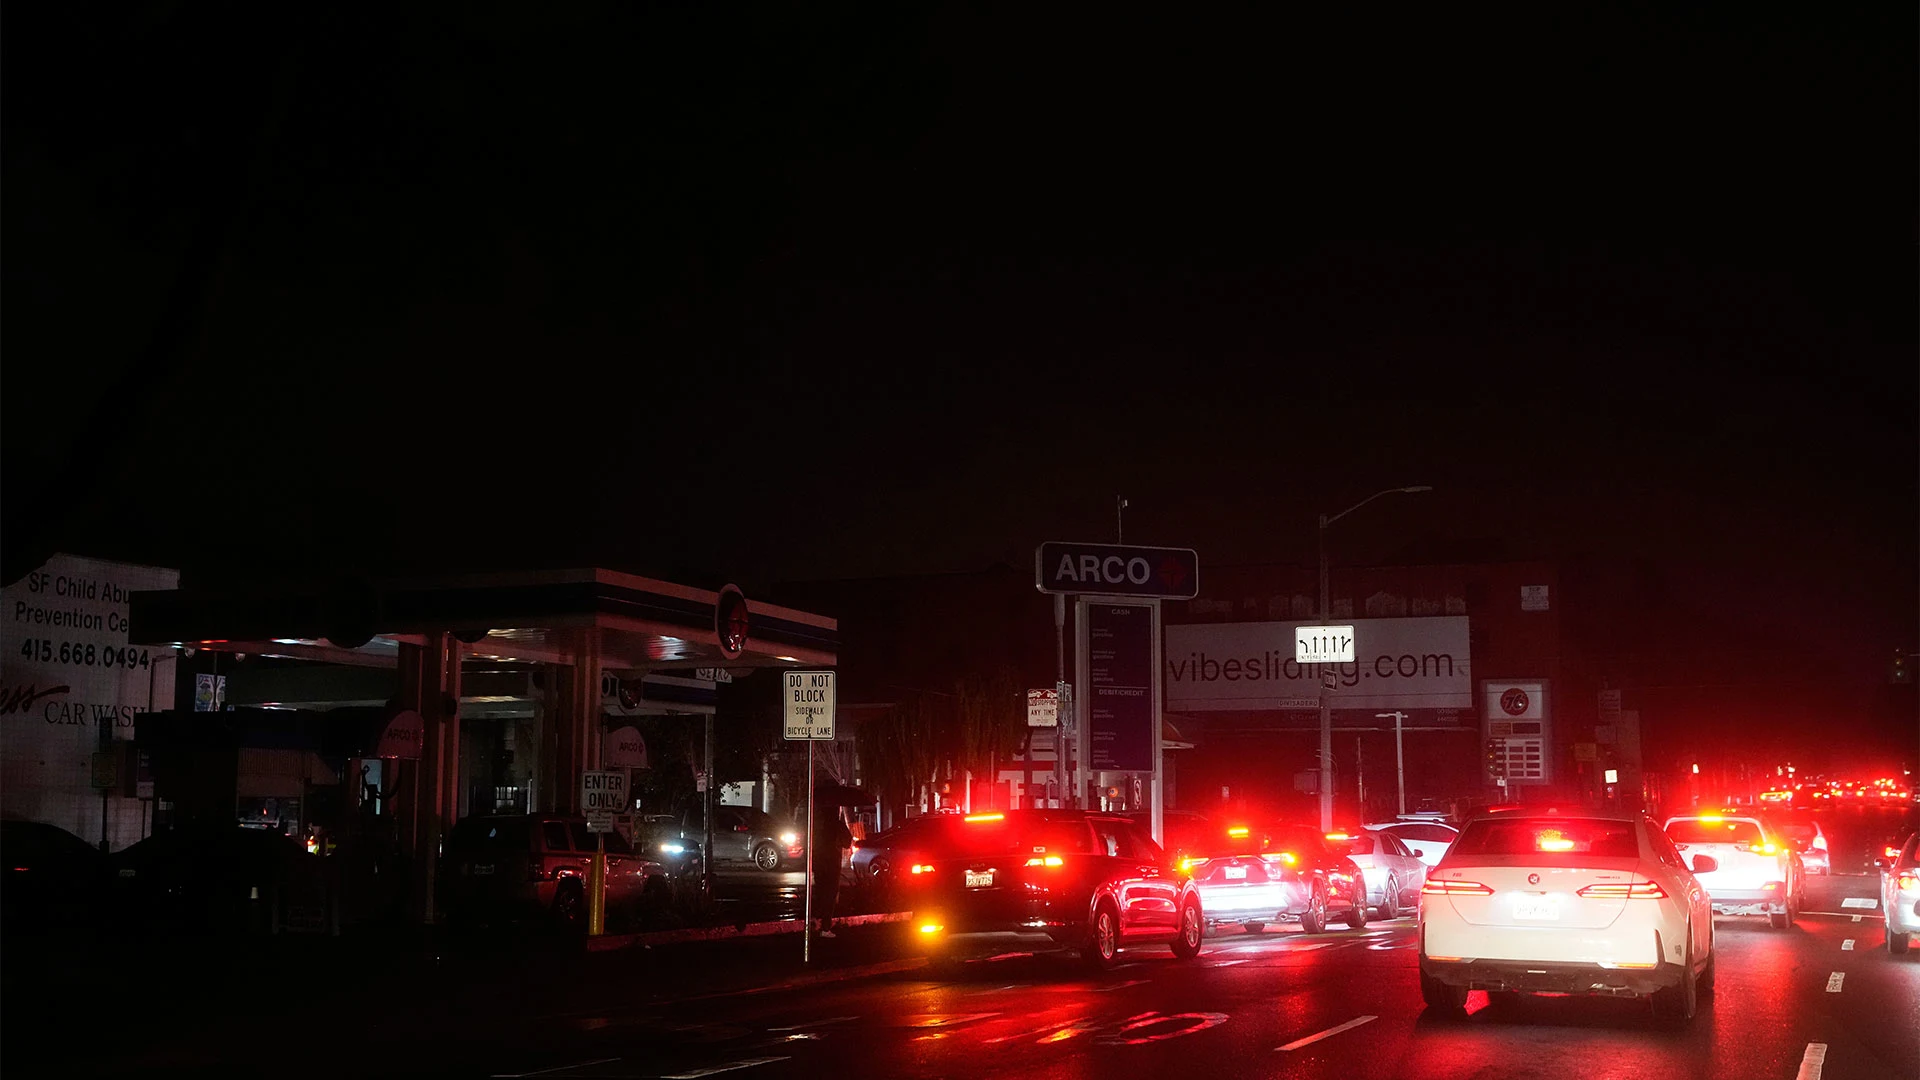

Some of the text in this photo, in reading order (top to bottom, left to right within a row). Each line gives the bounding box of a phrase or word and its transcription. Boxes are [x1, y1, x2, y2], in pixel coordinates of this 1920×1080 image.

[1056, 553, 1151, 585] ARCO
[28, 572, 50, 594] SF
[56, 576, 96, 600] Child
[15, 601, 102, 630] Prevention
[21, 638, 149, 670] 415.668.0494
[790, 675, 829, 687] DO NOT
[794, 690, 825, 702] BLOCK
[1504, 693, 1525, 711] 76
[44, 701, 146, 728] CAR WAS
[795, 707, 825, 715] SIDEWALK
[788, 727, 831, 735] BICYCLE LANE
[618, 742, 638, 753] ARCO
[585, 775, 622, 790] ENTER
[588, 793, 617, 809] ONLY
